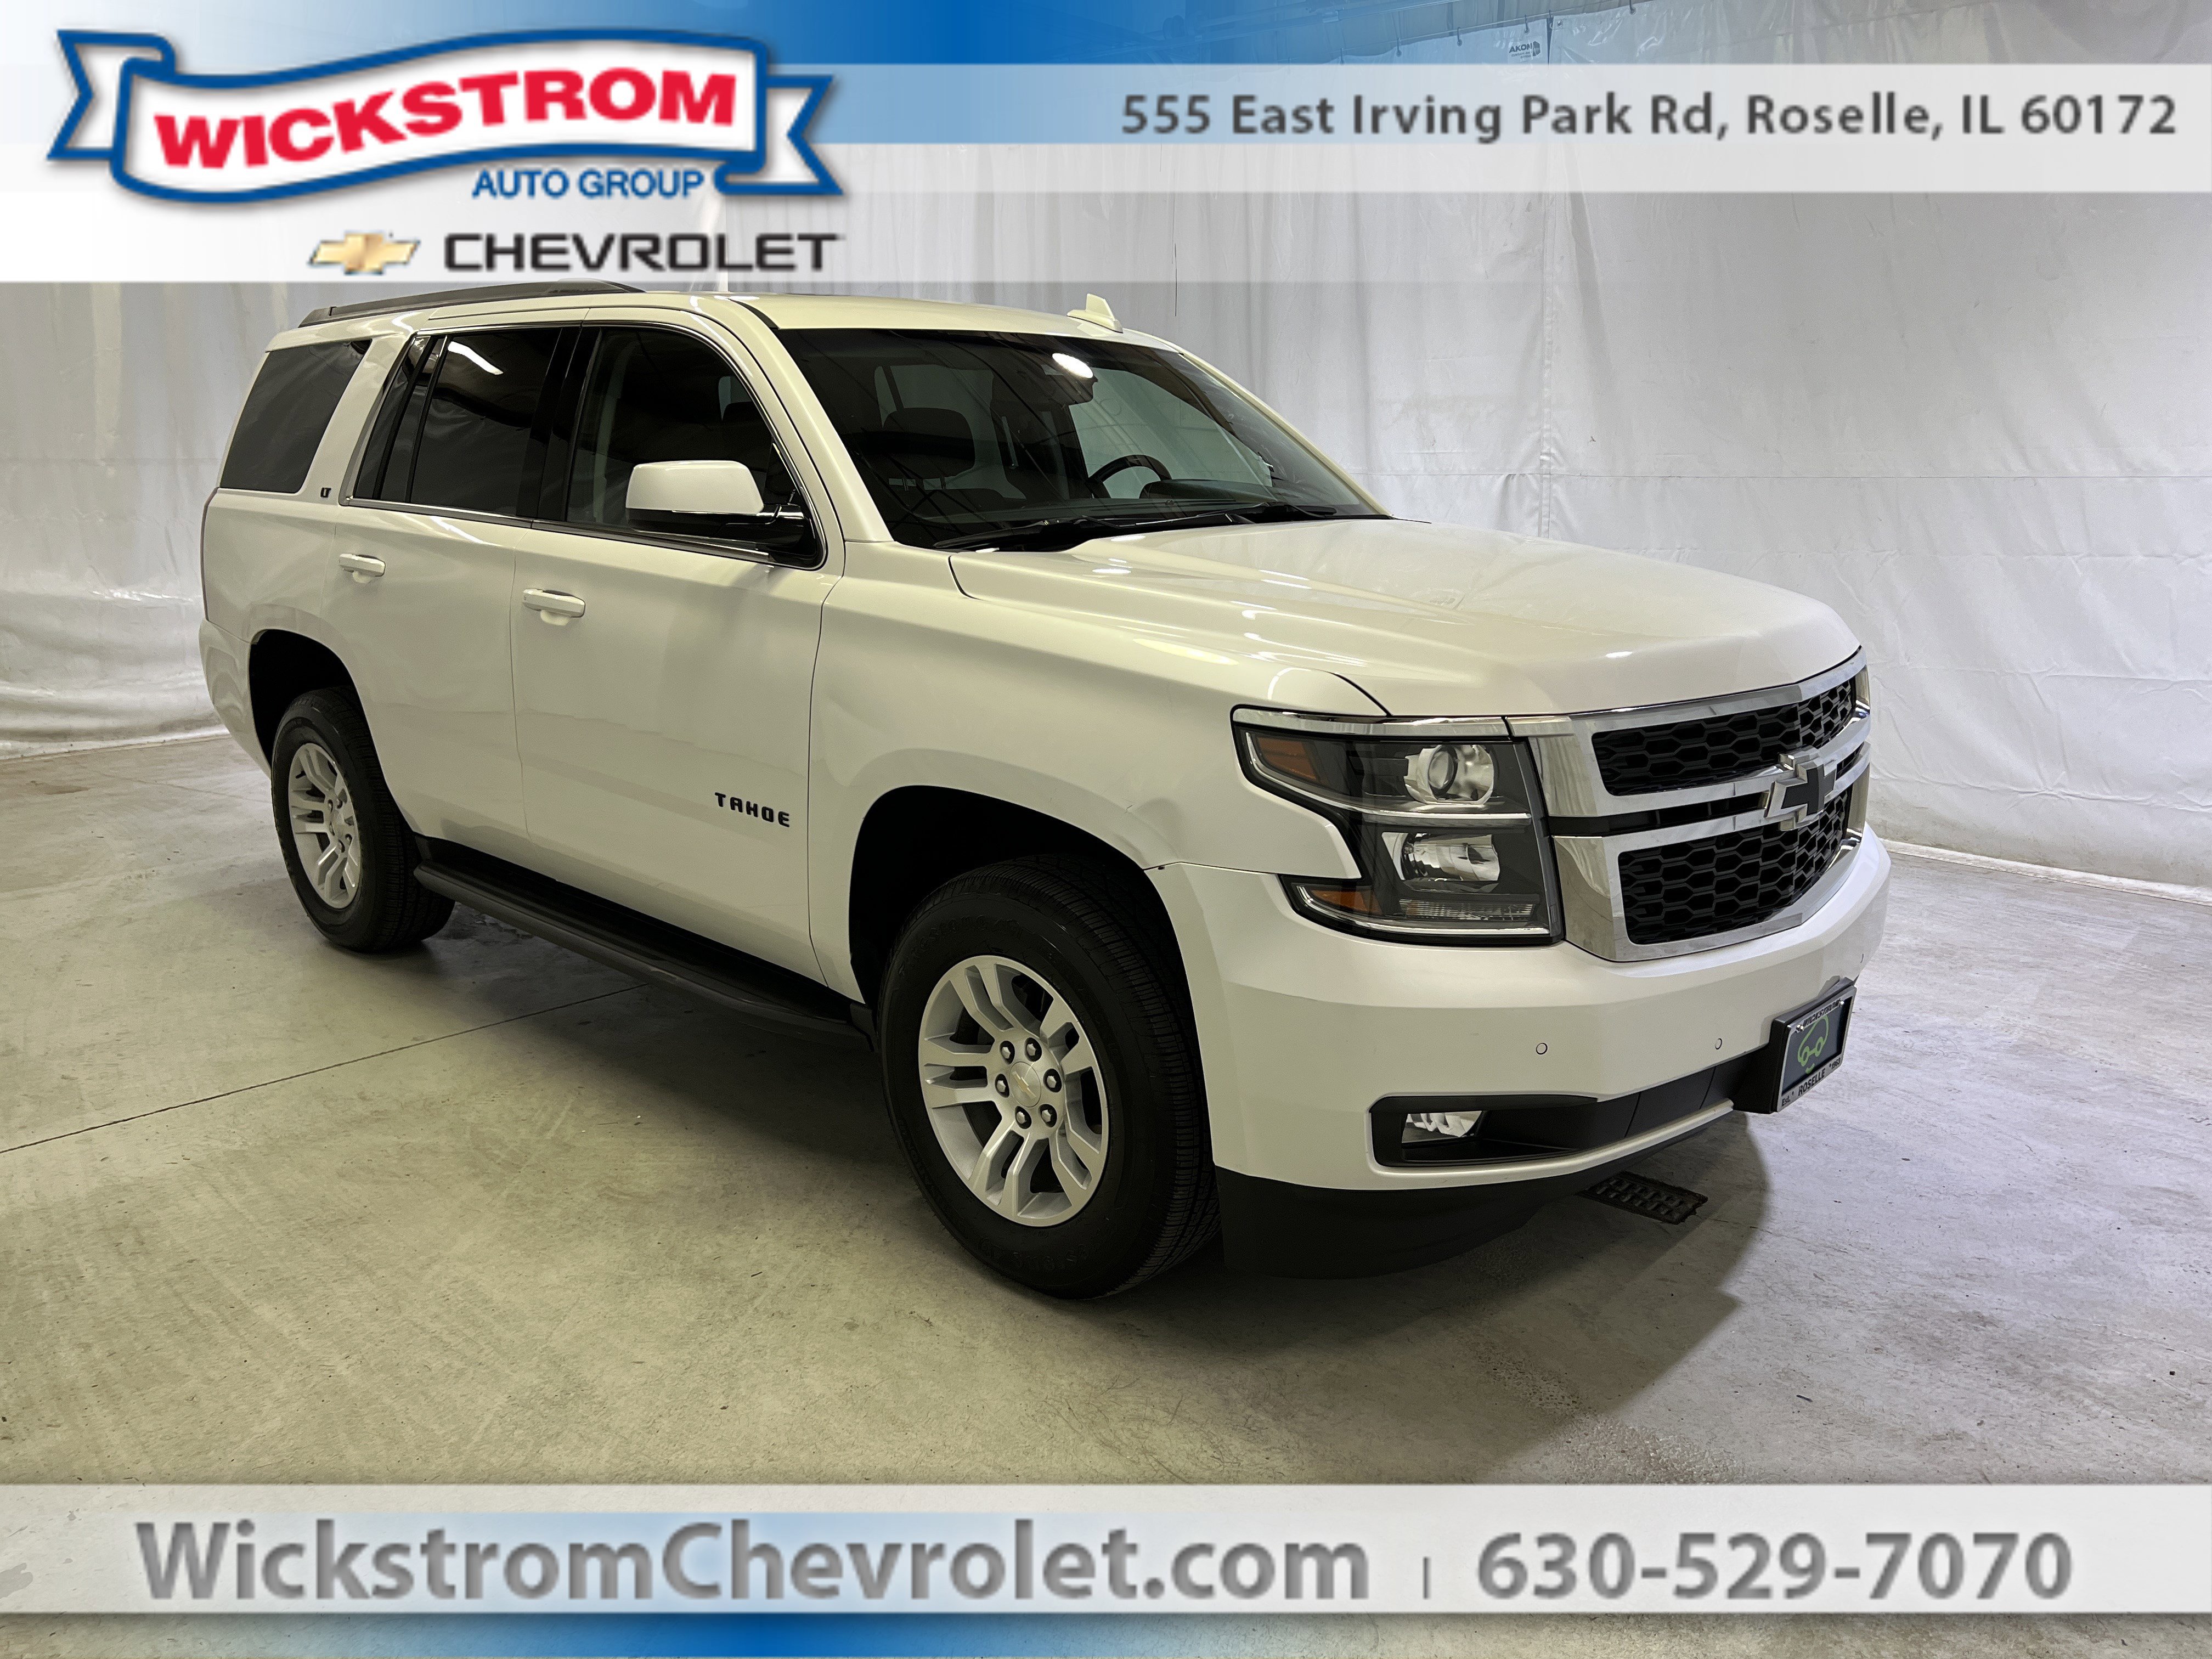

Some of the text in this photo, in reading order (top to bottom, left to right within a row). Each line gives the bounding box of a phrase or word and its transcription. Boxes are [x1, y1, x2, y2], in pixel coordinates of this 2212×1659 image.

[1509, 43, 1532, 53] AKON
[714, 792, 790, 827] TAHOE
[1798, 1068, 1826, 1097] ROSELLE
